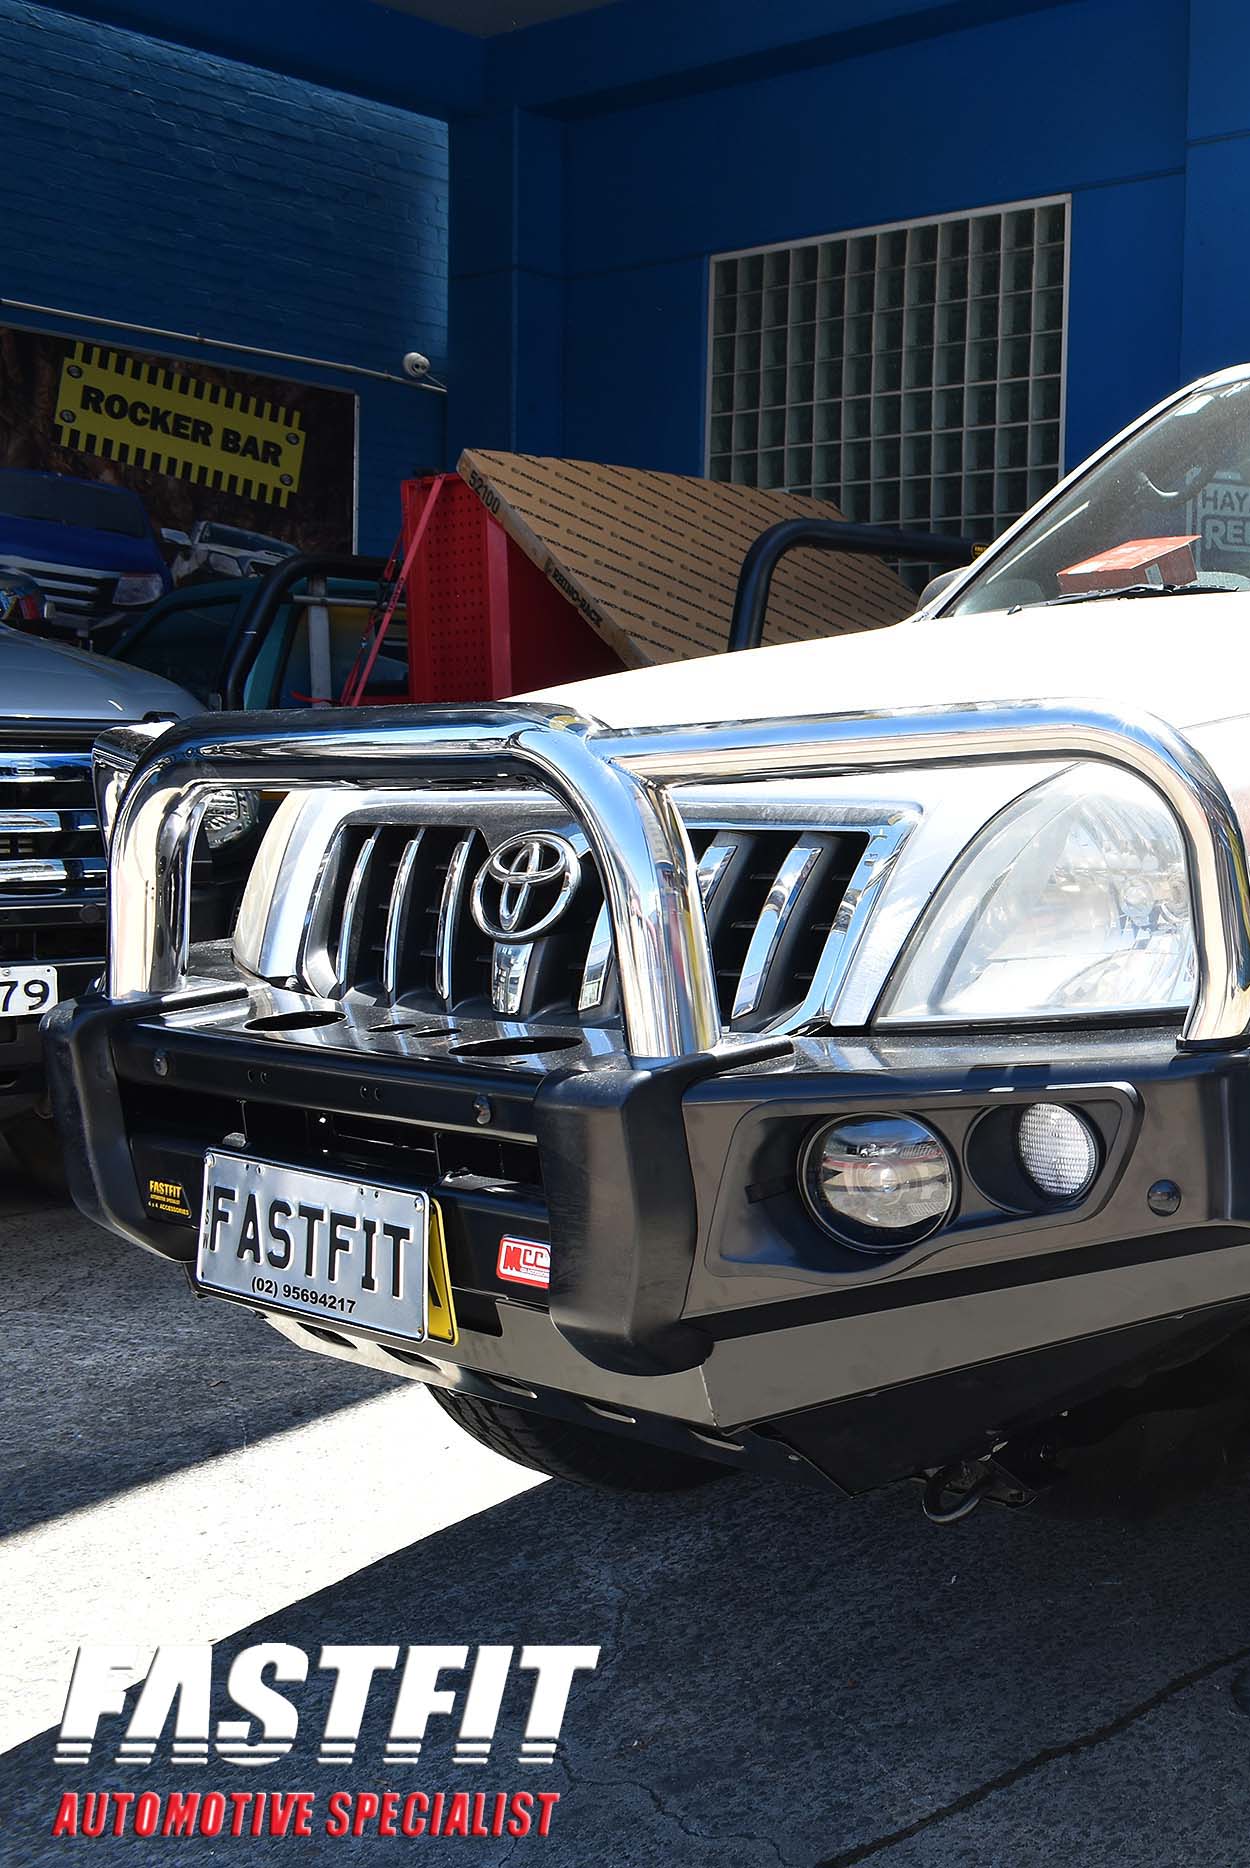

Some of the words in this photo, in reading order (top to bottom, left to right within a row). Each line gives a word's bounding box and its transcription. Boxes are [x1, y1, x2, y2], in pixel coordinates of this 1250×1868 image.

[80, 385, 214, 446] ROCKER
[220, 428, 282, 467] BAR
[469, 470, 500, 514] 52100
[149, 1180, 182, 1199] FASTFIT
[209, 1187, 413, 1300] FASTFIT
[503, 1245, 549, 1271] MCC
[251, 1275, 279, 1299] (02)
[282, 1284, 356, 1314] 95694217
